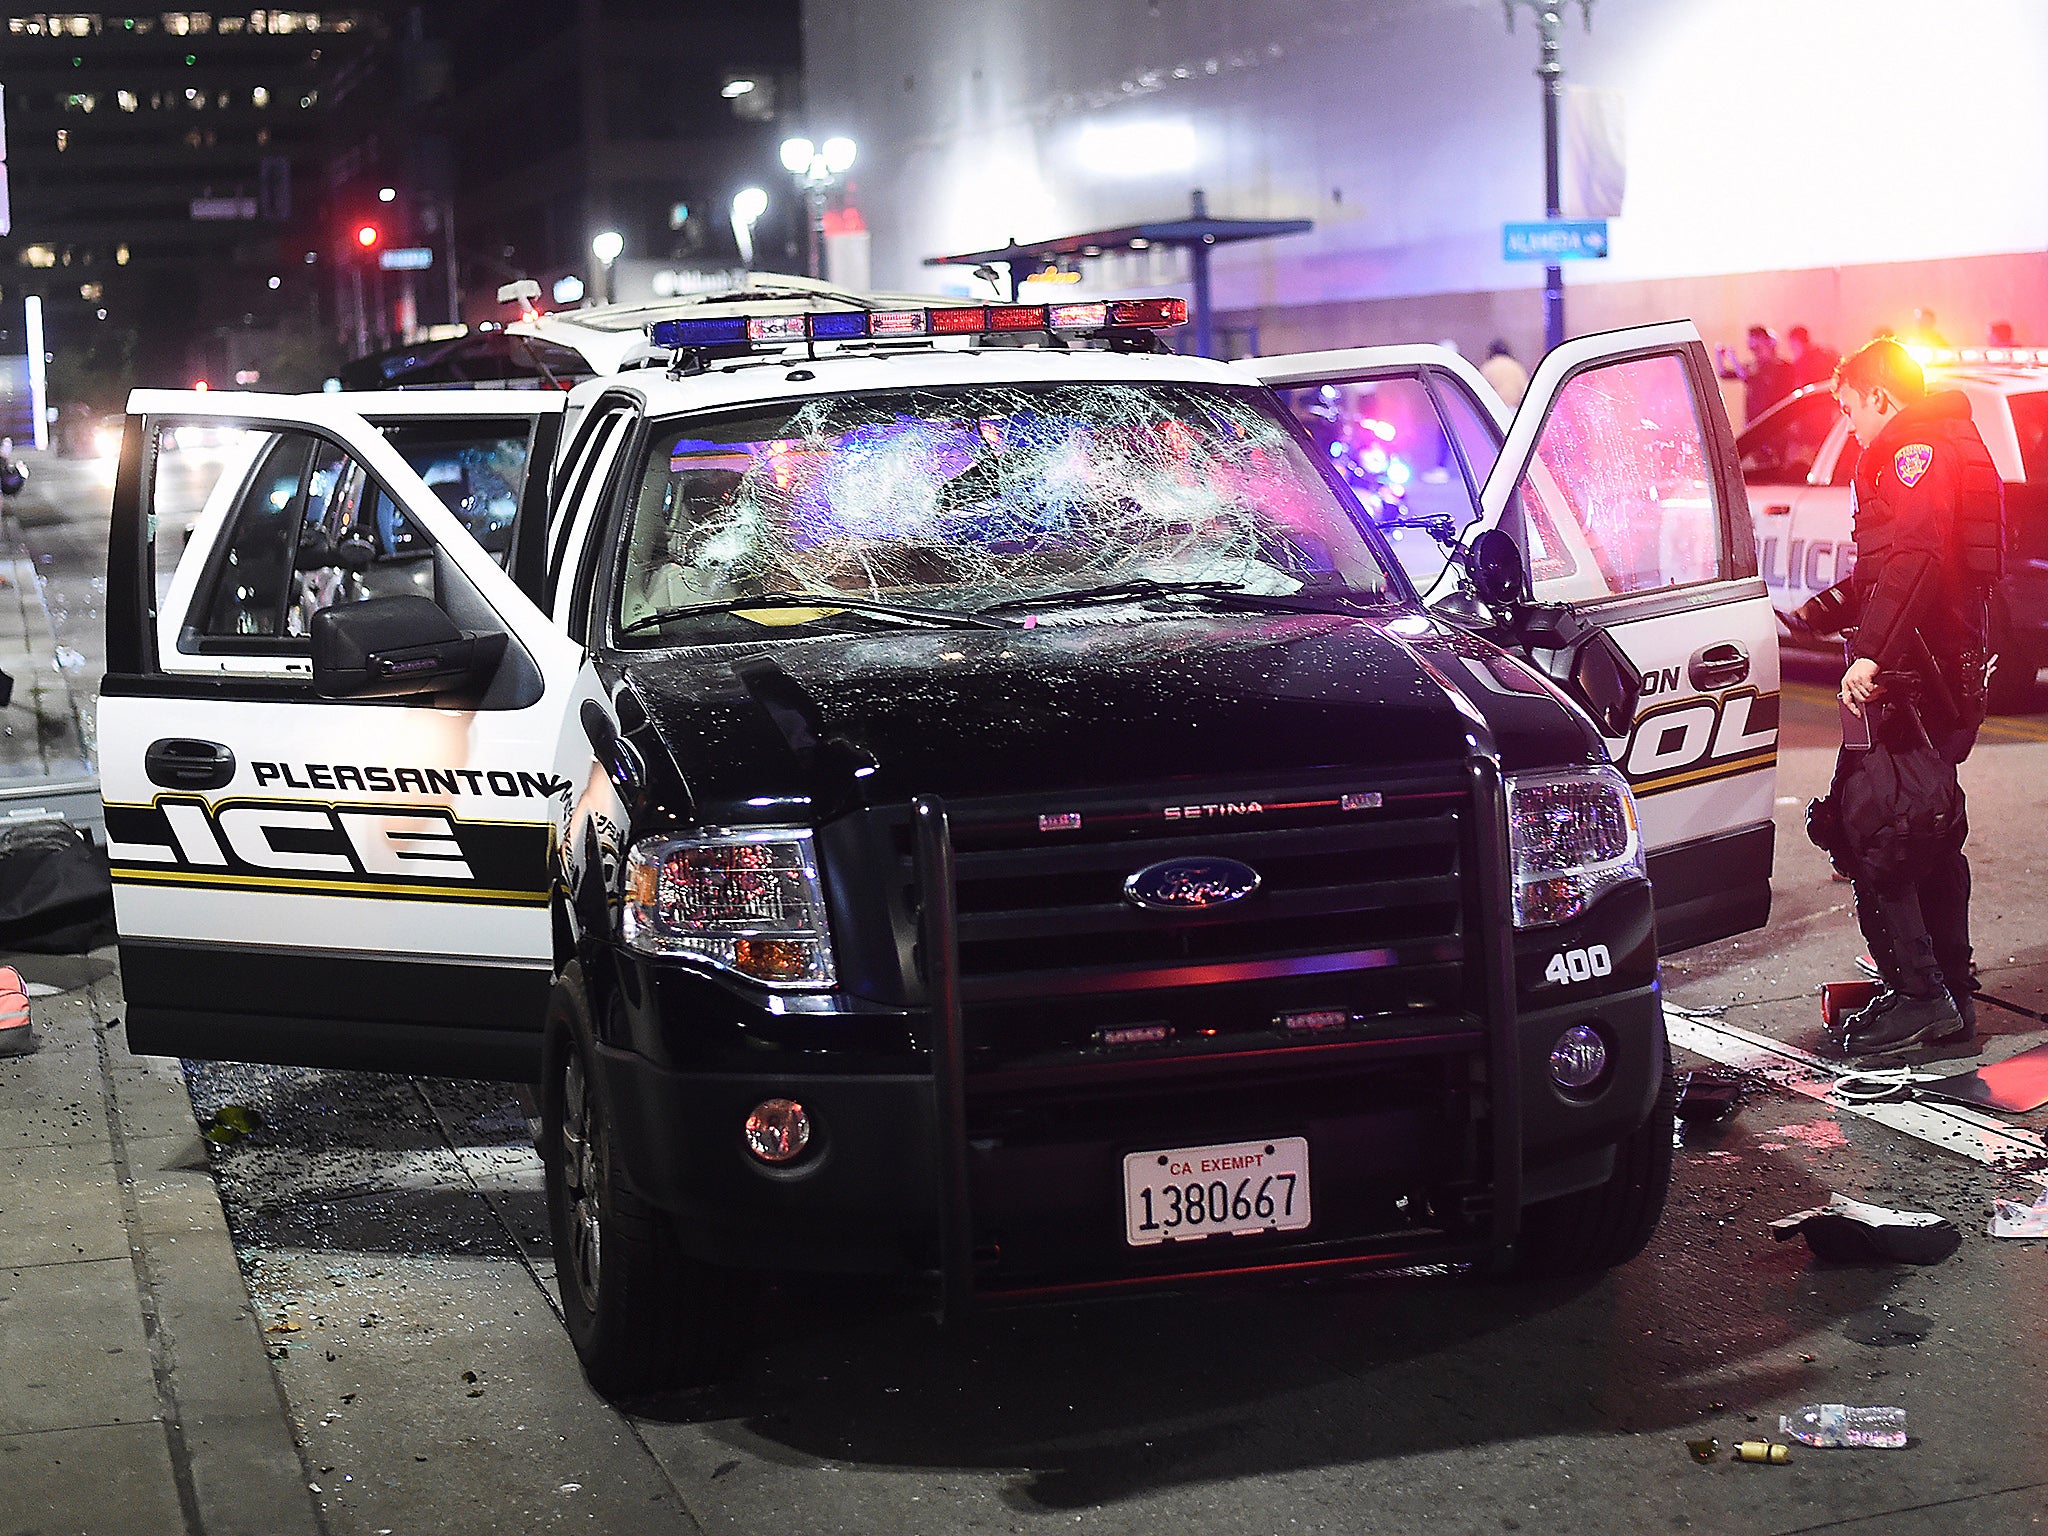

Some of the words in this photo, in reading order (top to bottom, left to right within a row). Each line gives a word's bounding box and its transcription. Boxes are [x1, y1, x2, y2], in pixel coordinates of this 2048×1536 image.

[252, 761, 551, 798] PLEASANTON
[1164, 802, 1263, 819] SETINA
[1545, 944, 1612, 985] 400
[1170, 1162, 1192, 1175] CA
[1201, 1154, 1264, 1173] EXEMPT
[1139, 1172, 1297, 1231] 1380667
